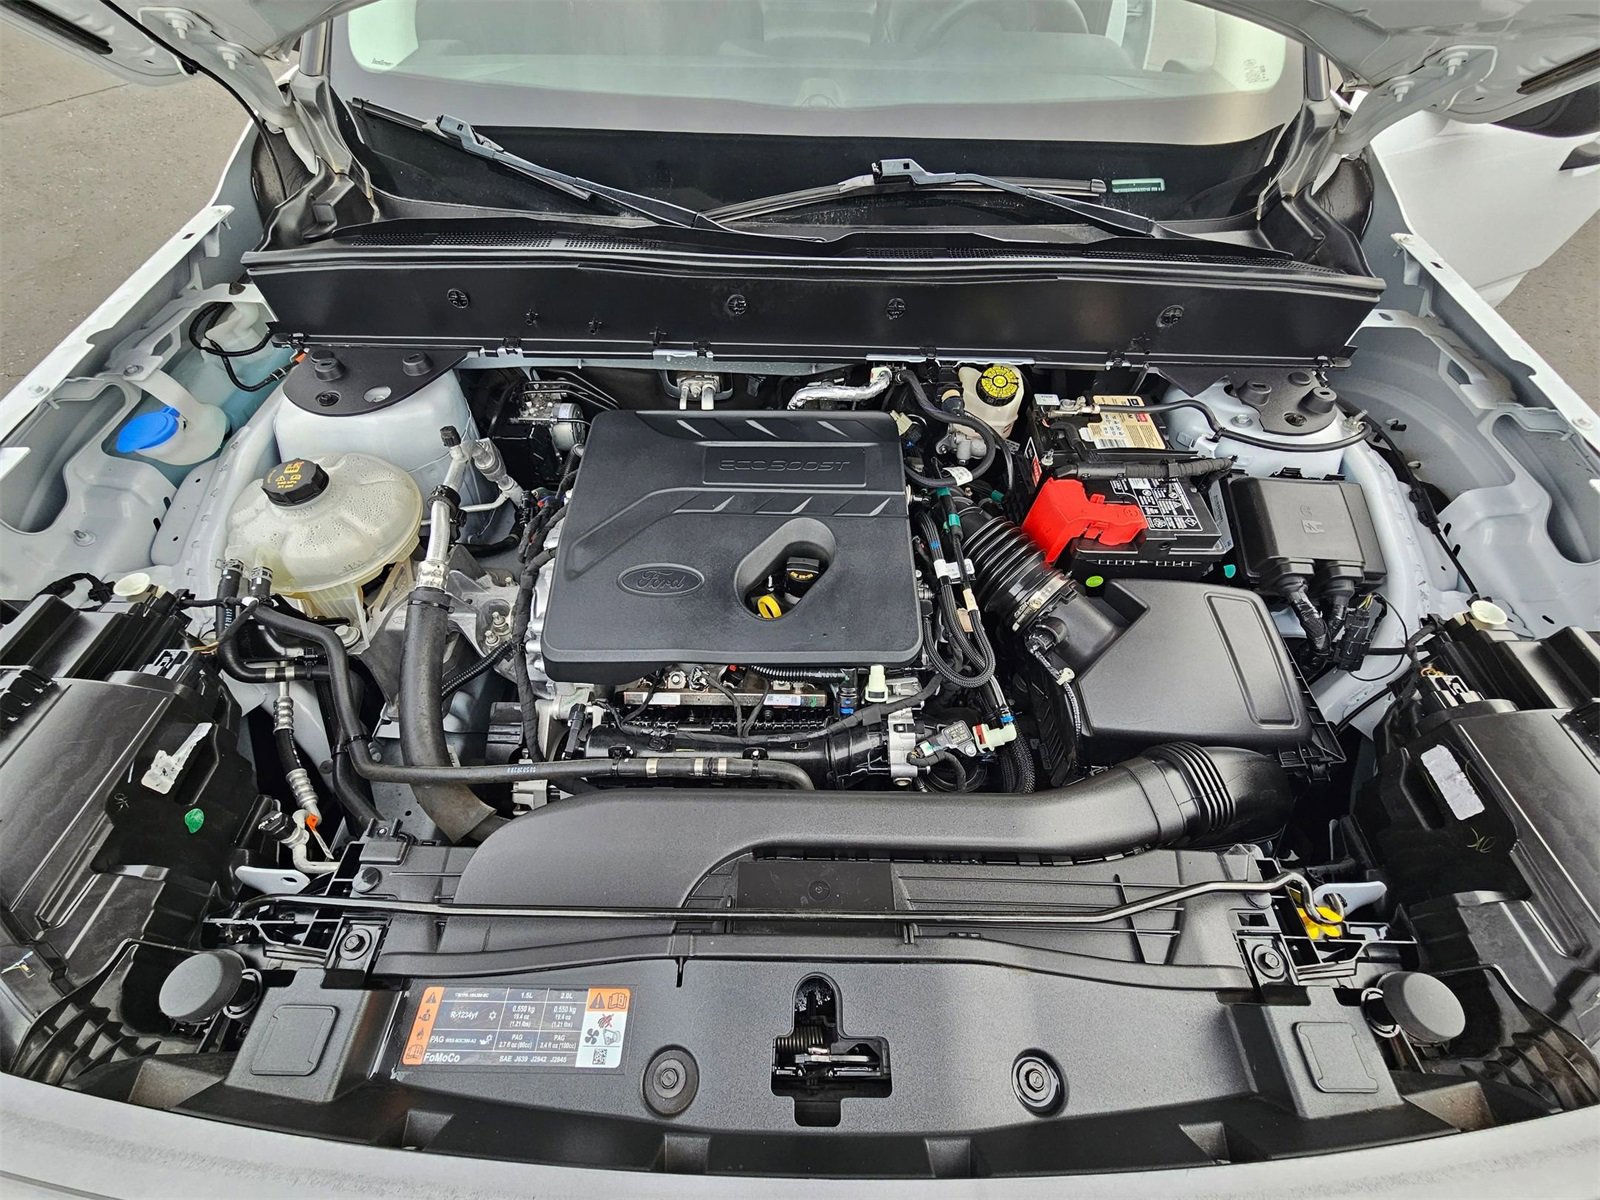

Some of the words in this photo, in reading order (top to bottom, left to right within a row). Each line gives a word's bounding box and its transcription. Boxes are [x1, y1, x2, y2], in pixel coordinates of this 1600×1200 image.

[719, 459, 851, 472] ECOBOOST
[636, 570, 687, 590] Ford
[527, 1005, 535, 1014] kg
[553, 1005, 569, 1013] 0.550
[569, 1006, 577, 1015] kg
[450, 1010, 478, 1020] R-1234yf
[429, 1035, 444, 1043] PAG
[423, 1053, 460, 1062] FoMoCo
